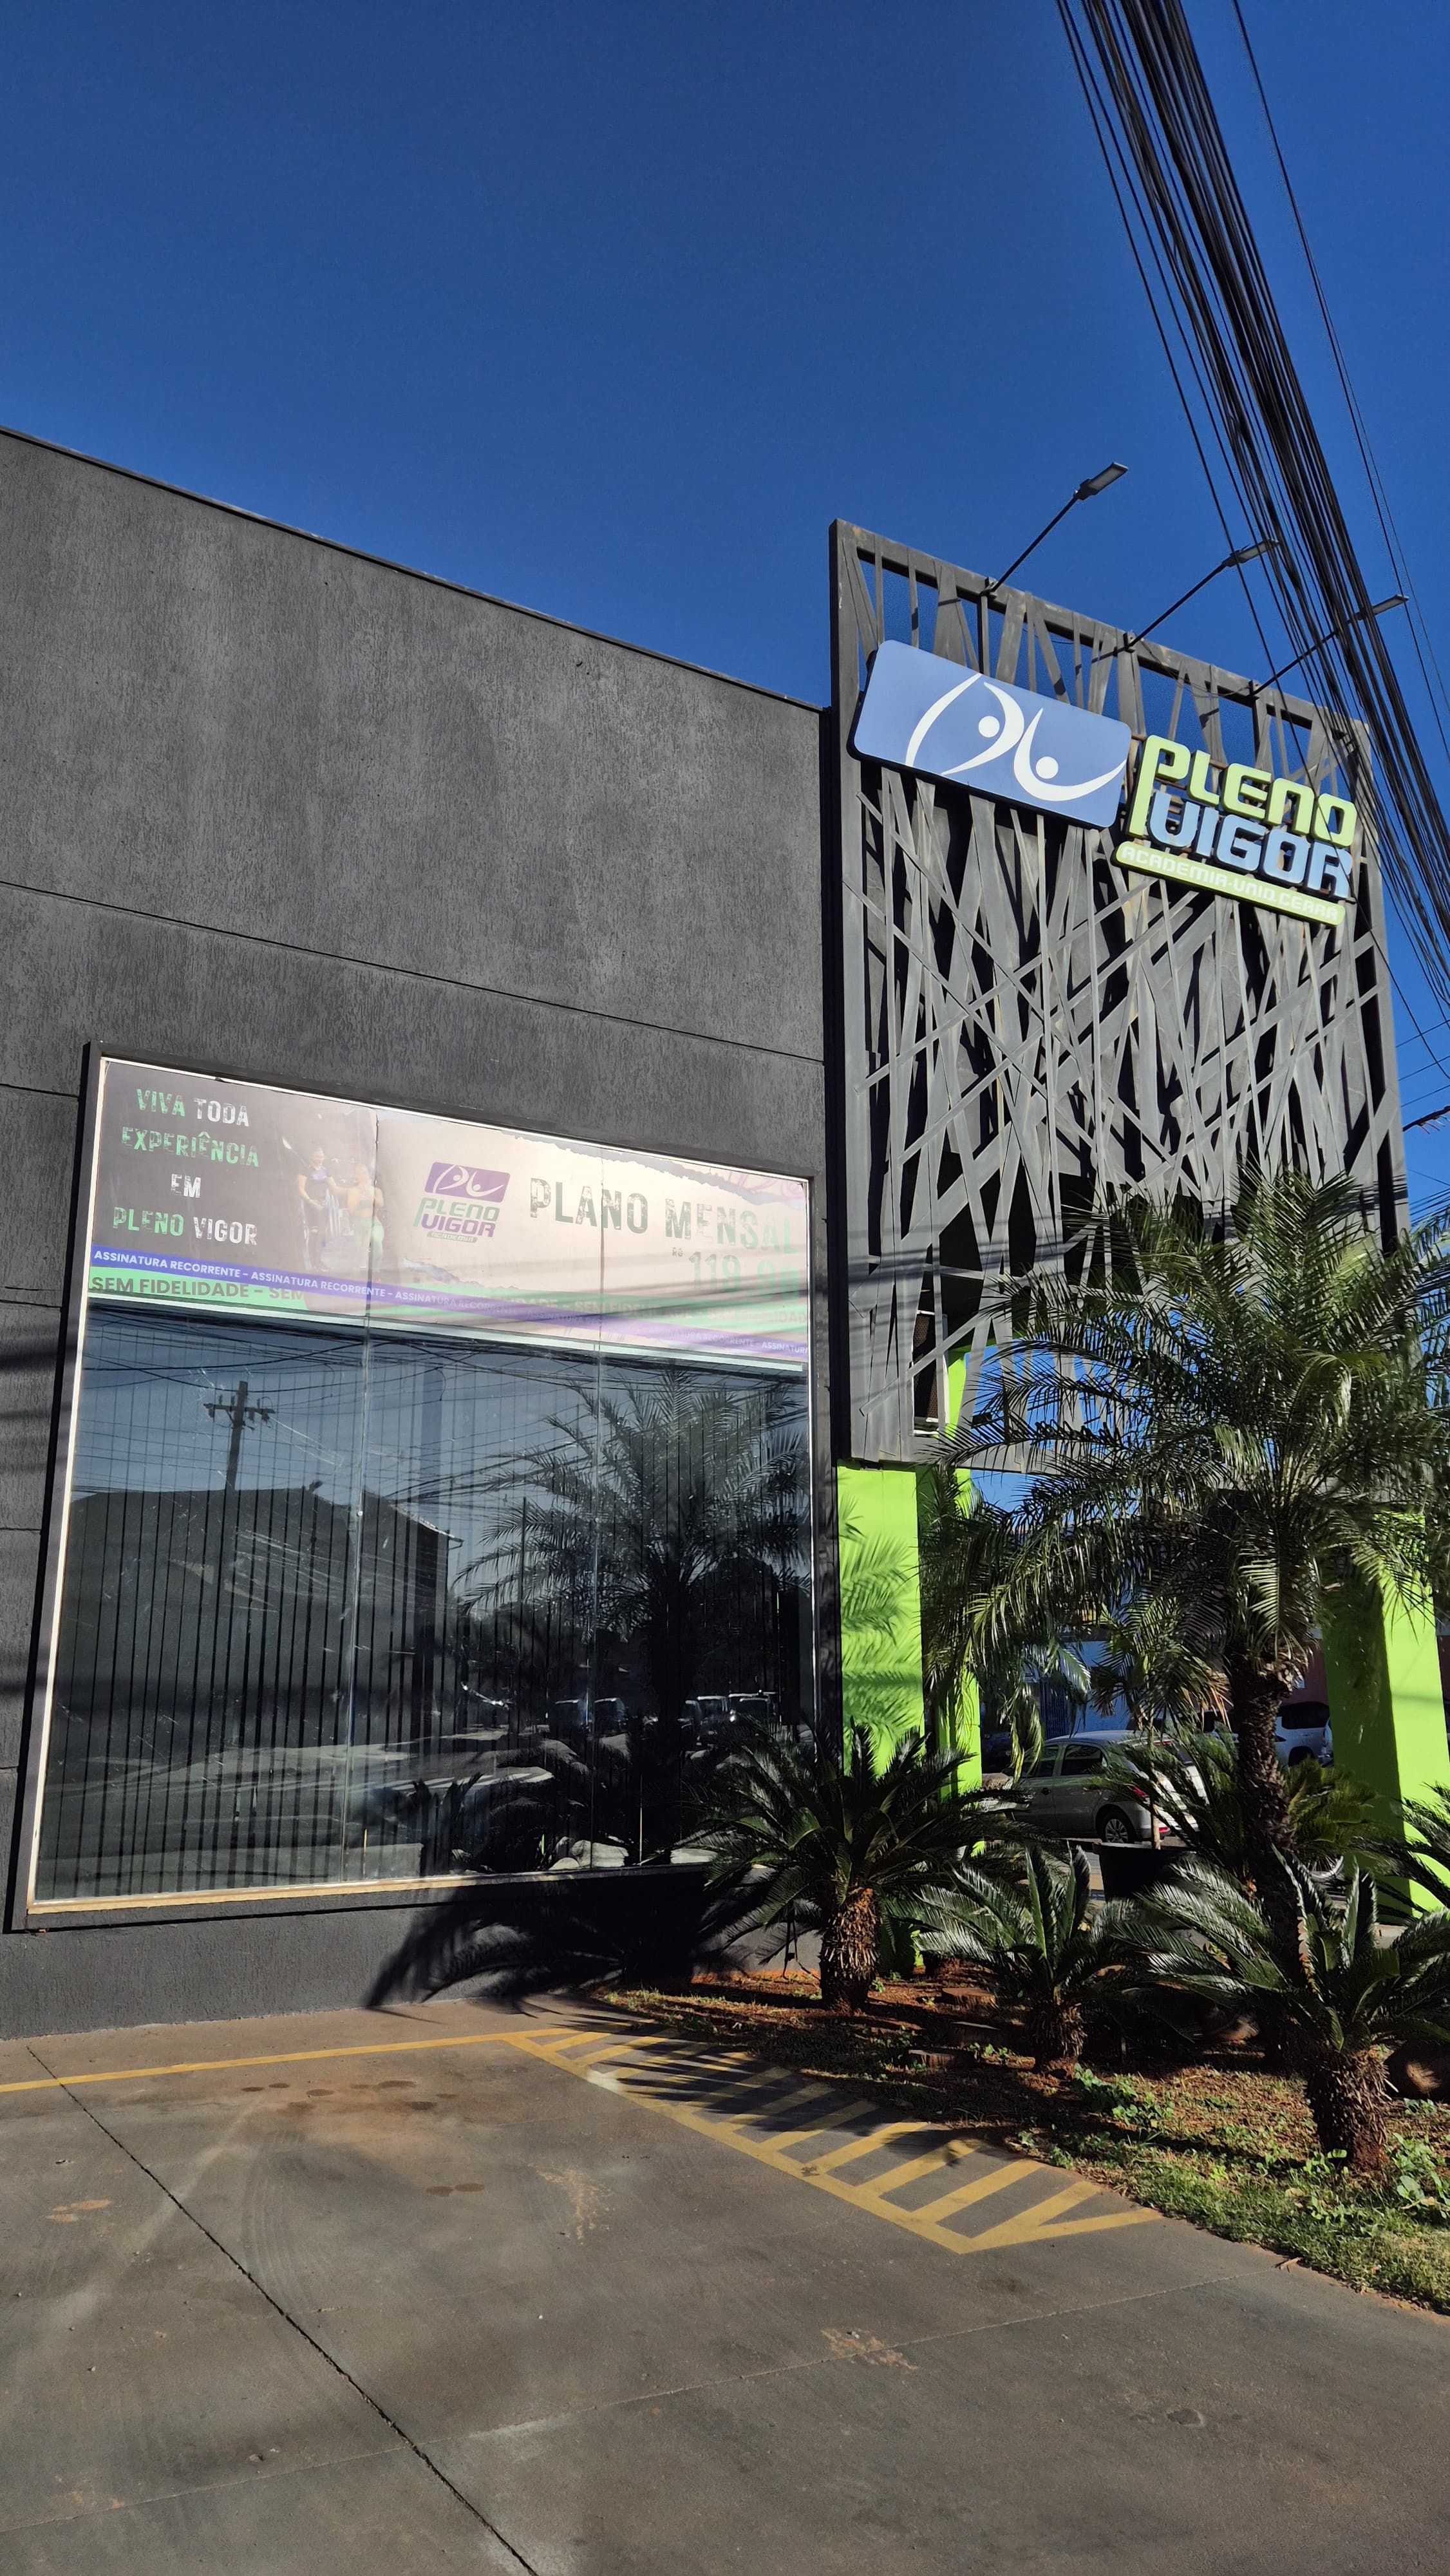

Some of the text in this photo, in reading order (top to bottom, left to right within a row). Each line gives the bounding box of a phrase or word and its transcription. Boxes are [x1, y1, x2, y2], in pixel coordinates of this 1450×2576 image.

[1127, 734, 1357, 848] PLENO
[1149, 790, 1353, 898] VIGOR
[137, 1088, 250, 1127] VIVA TODA
[122, 1126, 259, 1168] EXPERIÊNCIA
[170, 1173, 202, 1198] EM
[113, 1207, 258, 1245] PLENO VIGOR
[413, 1197, 500, 1227] PLENO
[421, 1213, 496, 1237] VIGOR
[530, 1177, 799, 1255] PLANO MENSAL
[91, 1276, 134, 1293] SEM
[139, 1278, 249, 1298] FIDELIDADE
[94, 1250, 168, 1268] ASSINATURA
[170, 1260, 241, 1278] RECORRENTE
[251, 1271, 318, 1289] ASSINATURA
[321, 1281, 386, 1297] RECORRENTE
[395, 1291, 459, 1307] ASSINATURA
